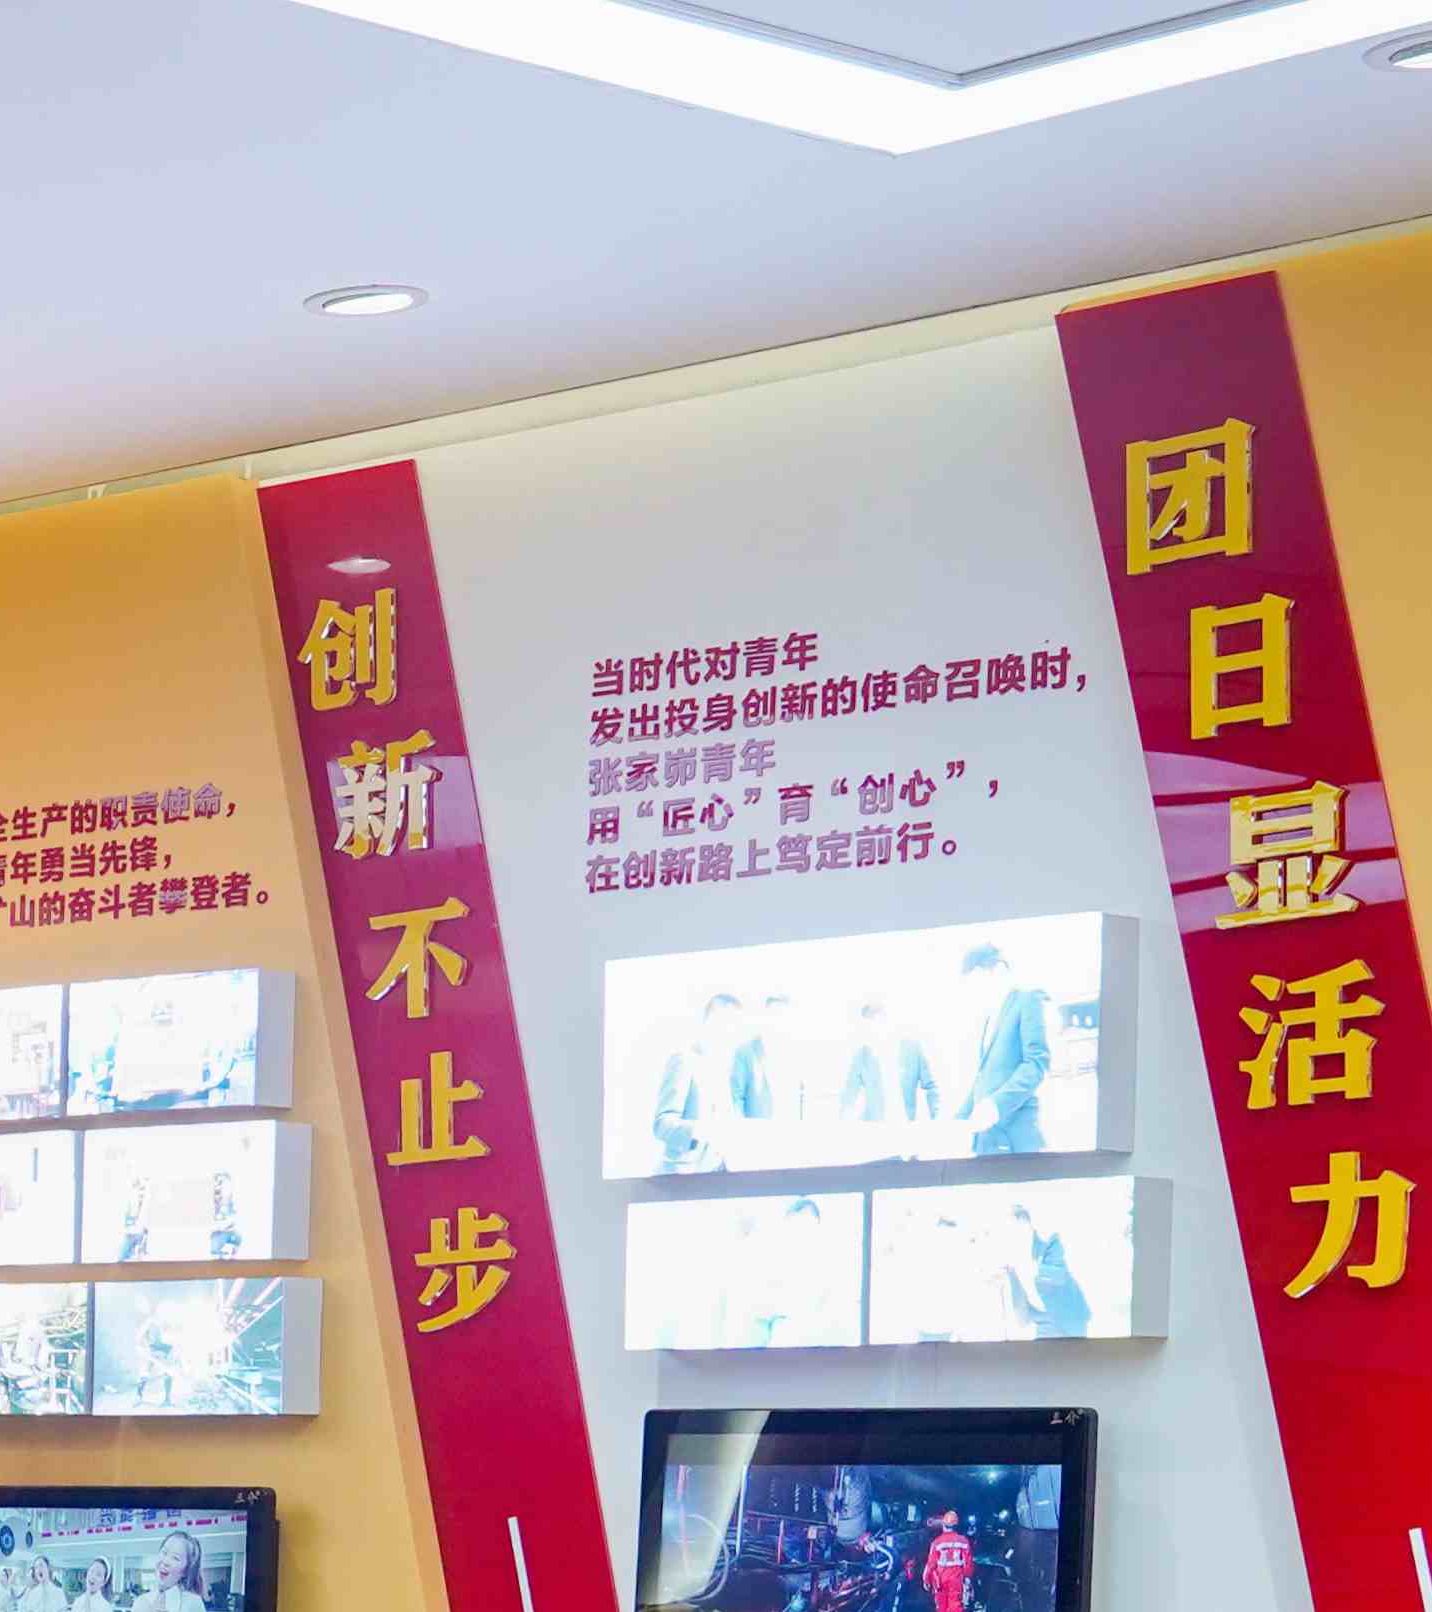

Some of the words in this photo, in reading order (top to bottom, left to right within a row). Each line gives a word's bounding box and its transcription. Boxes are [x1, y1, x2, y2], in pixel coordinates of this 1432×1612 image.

[589, 646, 1087, 746] 发出投身创新的使命召唤时，
[591, 632, 819, 698] 当时代对青年
[589, 738, 777, 797] 张家峁青年
[585, 821, 958, 894] 在创新路上笃定前行。
[1124, 416, 1418, 1300] 团日显活力
[297, 586, 517, 1334] 创新不止步
